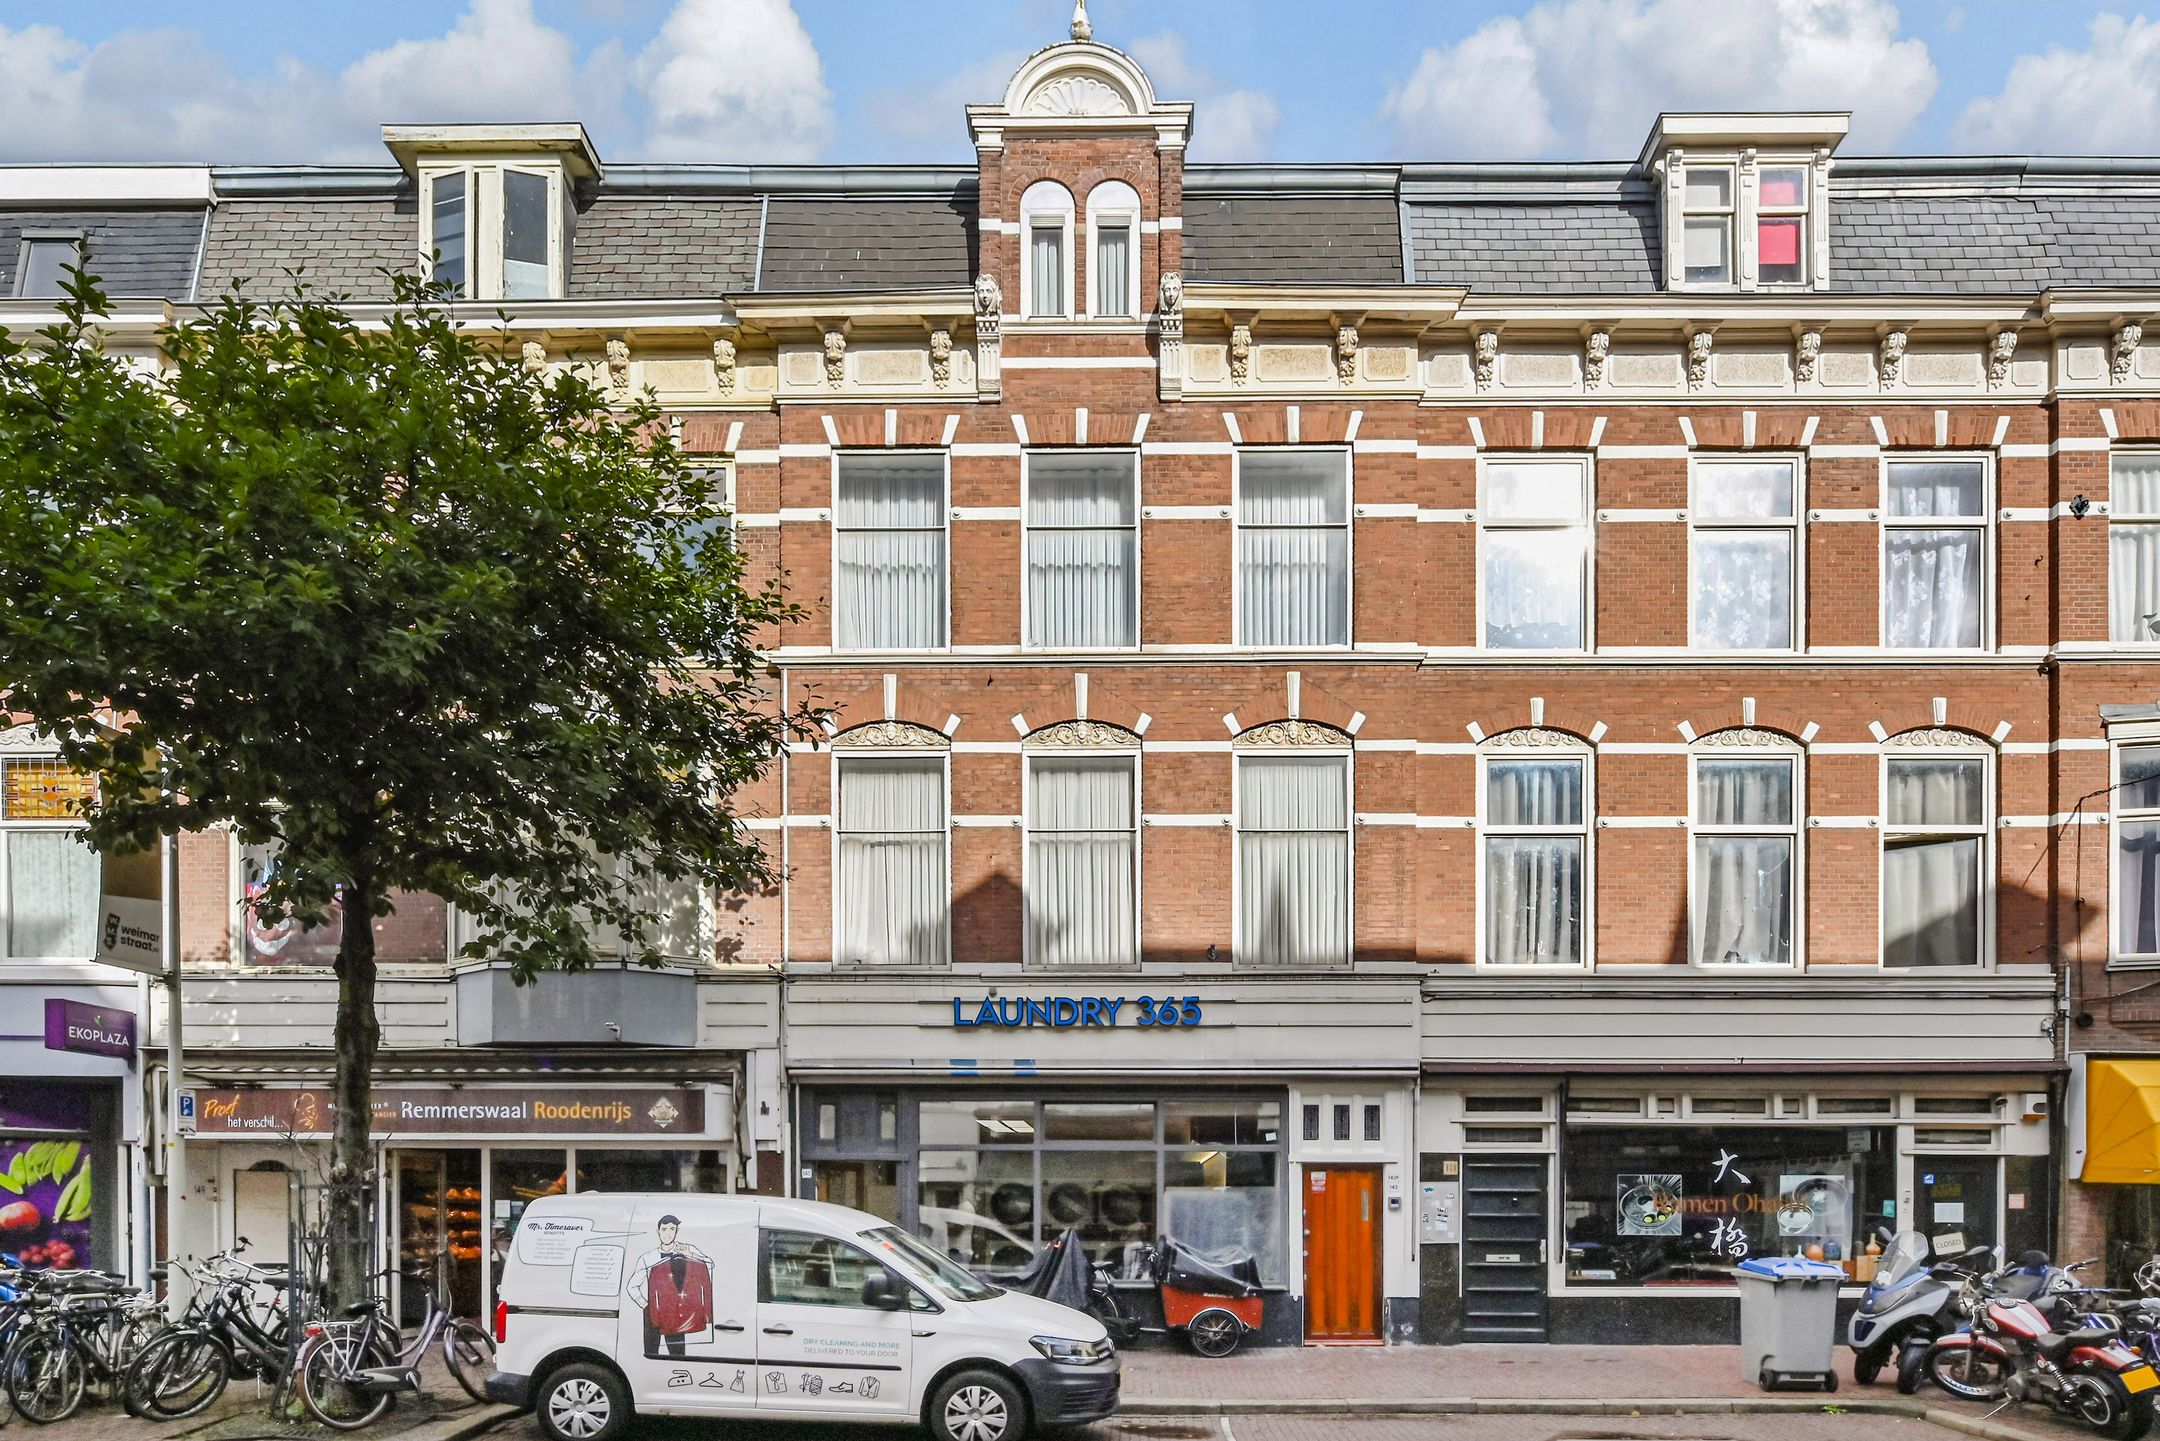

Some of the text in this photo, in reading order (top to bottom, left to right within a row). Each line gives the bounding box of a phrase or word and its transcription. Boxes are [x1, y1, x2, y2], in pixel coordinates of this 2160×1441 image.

[121, 925, 160, 942] weimar
[953, 996, 1202, 1027] LAUNDRY 365
[68, 1026, 130, 1046] EKOPLAZA
[401, 1101, 632, 1123] Remmerswaal Roodenrijs
[227, 1115, 241, 1128] het
[544, 1222, 583, 1231] Timesaver
[1935, 1239, 1962, 1249] CLOSED
[820, 1338, 859, 1348] CLEANING
[804, 1347, 843, 1355] DELIVERED
